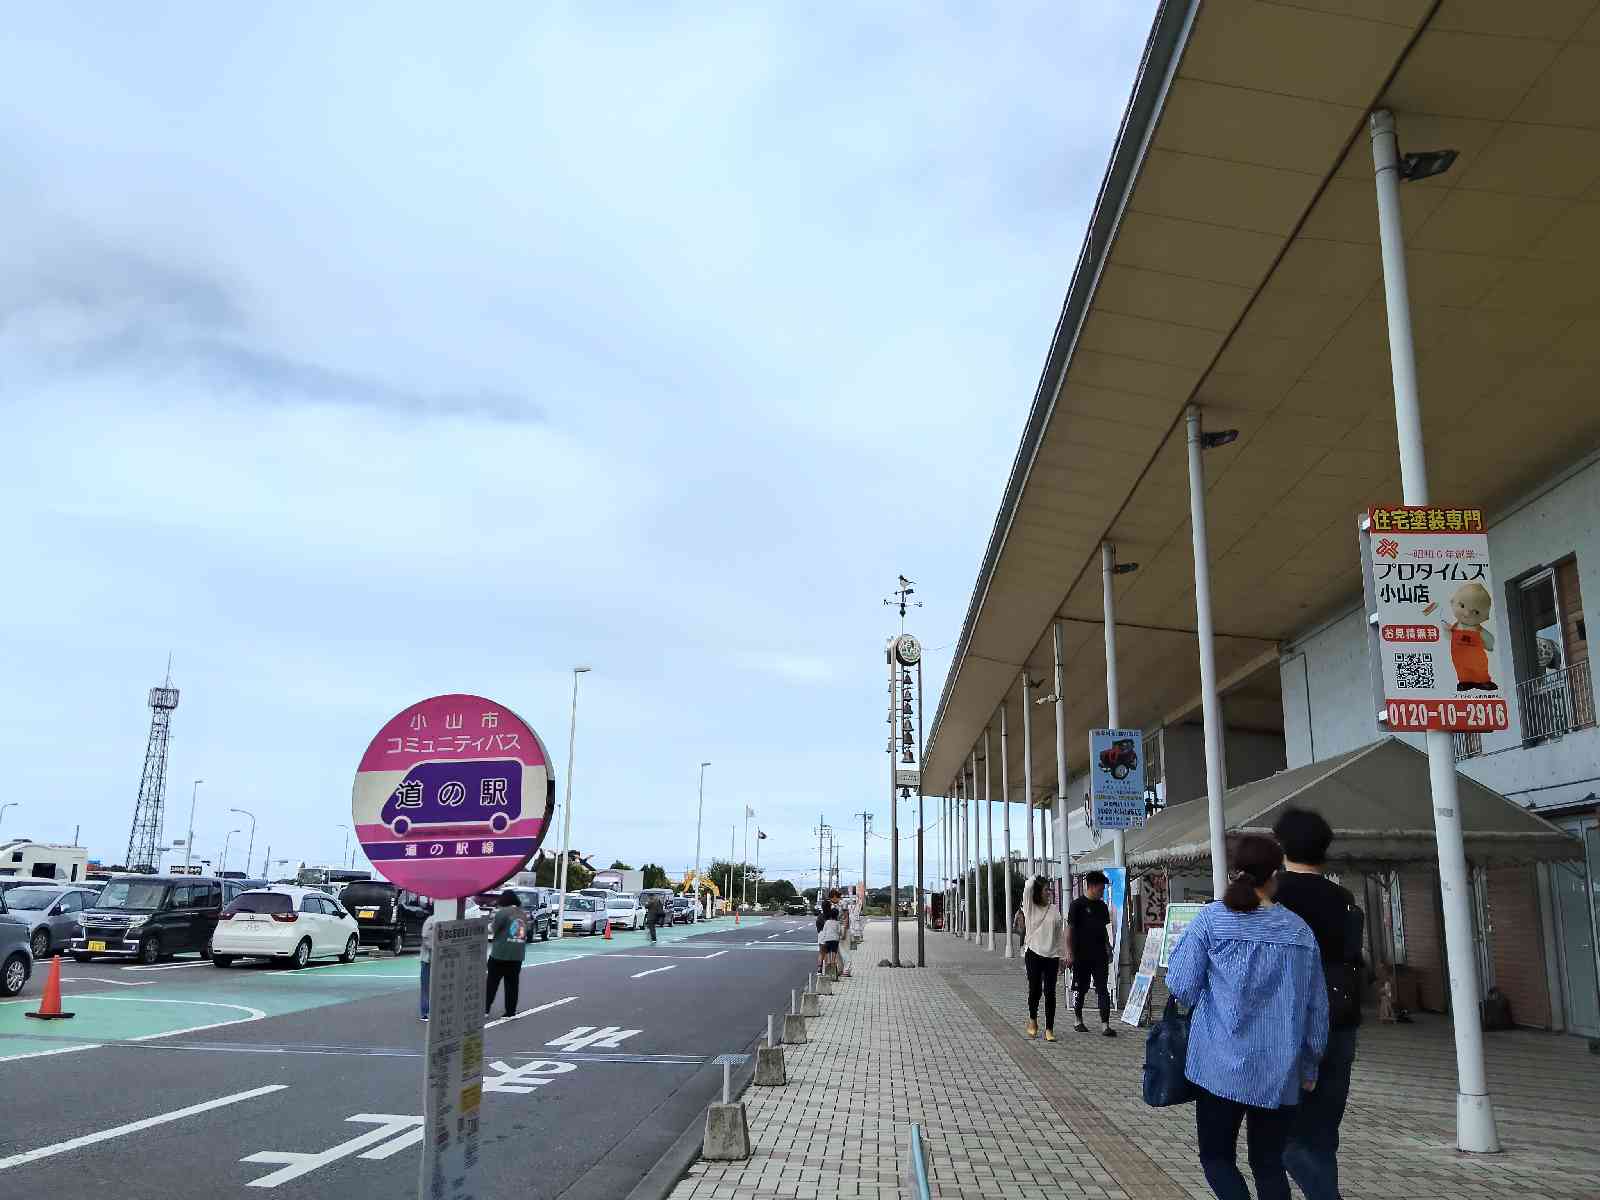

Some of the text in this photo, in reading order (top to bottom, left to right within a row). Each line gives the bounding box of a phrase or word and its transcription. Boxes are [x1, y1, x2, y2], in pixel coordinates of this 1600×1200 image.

[1373, 509, 1482, 531] 住宅塗装専門
[1375, 562, 1489, 581] プロタイムズ
[1380, 583, 1430, 604] 小山店
[410, 711, 499, 730] 小山市
[1388, 703, 1506, 726] 0120-10-2916
[386, 734, 521, 754] コミュニティバス
[396, 778, 508, 808] 道の駅
[405, 841, 494, 857] 道の駅線
